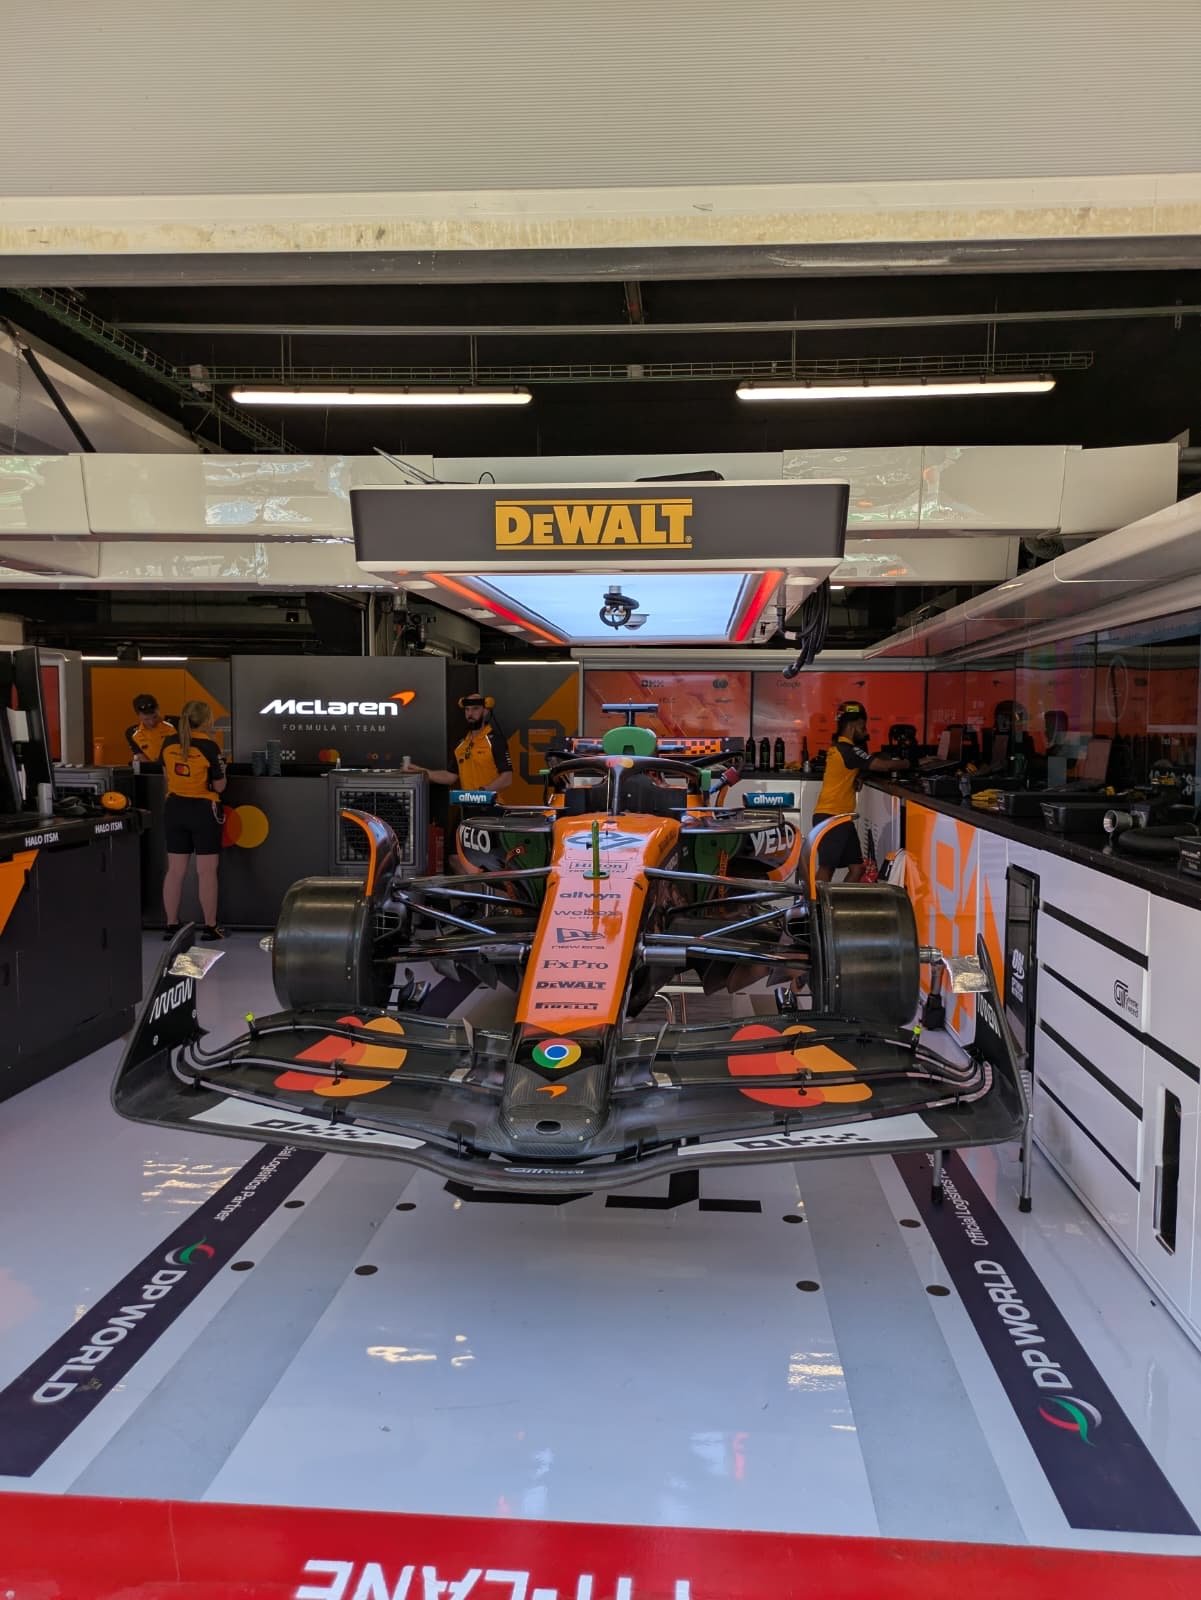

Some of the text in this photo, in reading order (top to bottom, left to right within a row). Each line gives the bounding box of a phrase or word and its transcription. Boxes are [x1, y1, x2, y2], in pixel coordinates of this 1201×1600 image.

[259, 699, 399, 716] McLaren
[283, 724, 337, 732] FORMULA
[356, 724, 386, 732] TEAM
[458, 792, 487, 804] allwyn
[753, 794, 784, 806] allwyn
[94, 821, 123, 834] HALO ITSM
[25, 832, 59, 847] HALO ITSM
[749, 824, 795, 857] VELO
[559, 891, 622, 901] allwyn
[543, 960, 609, 970] FxPro
[535, 1002, 599, 1010] PIRELLI
[214, 1190, 256, 1222] Partner
[956, 1215, 989, 1246] Official
[974, 1260, 1073, 1389] DP WORLD
[32, 1269, 188, 1403] DP WORLD
